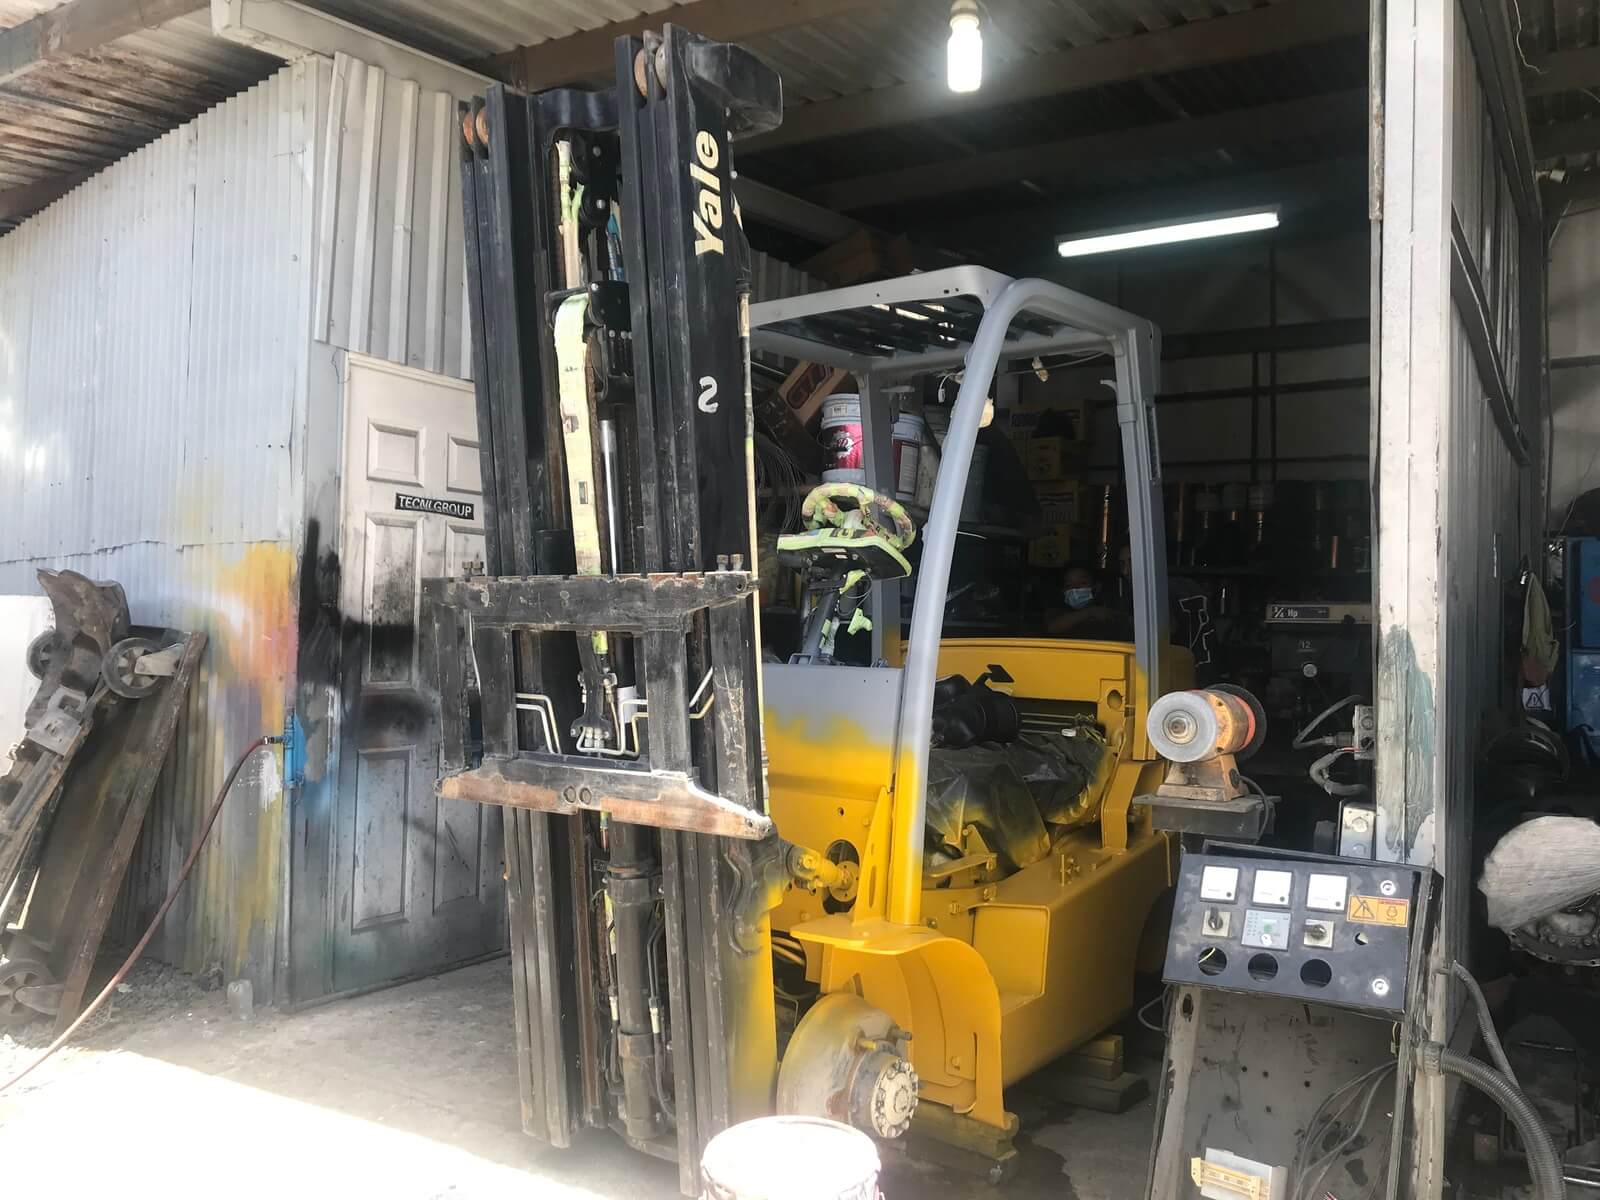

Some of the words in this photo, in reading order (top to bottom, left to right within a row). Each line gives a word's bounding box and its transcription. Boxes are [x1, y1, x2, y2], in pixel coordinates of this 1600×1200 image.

[690, 130, 724, 256] Yale
[698, 376, 719, 413] 2
[433, 501, 472, 517] GROUP
